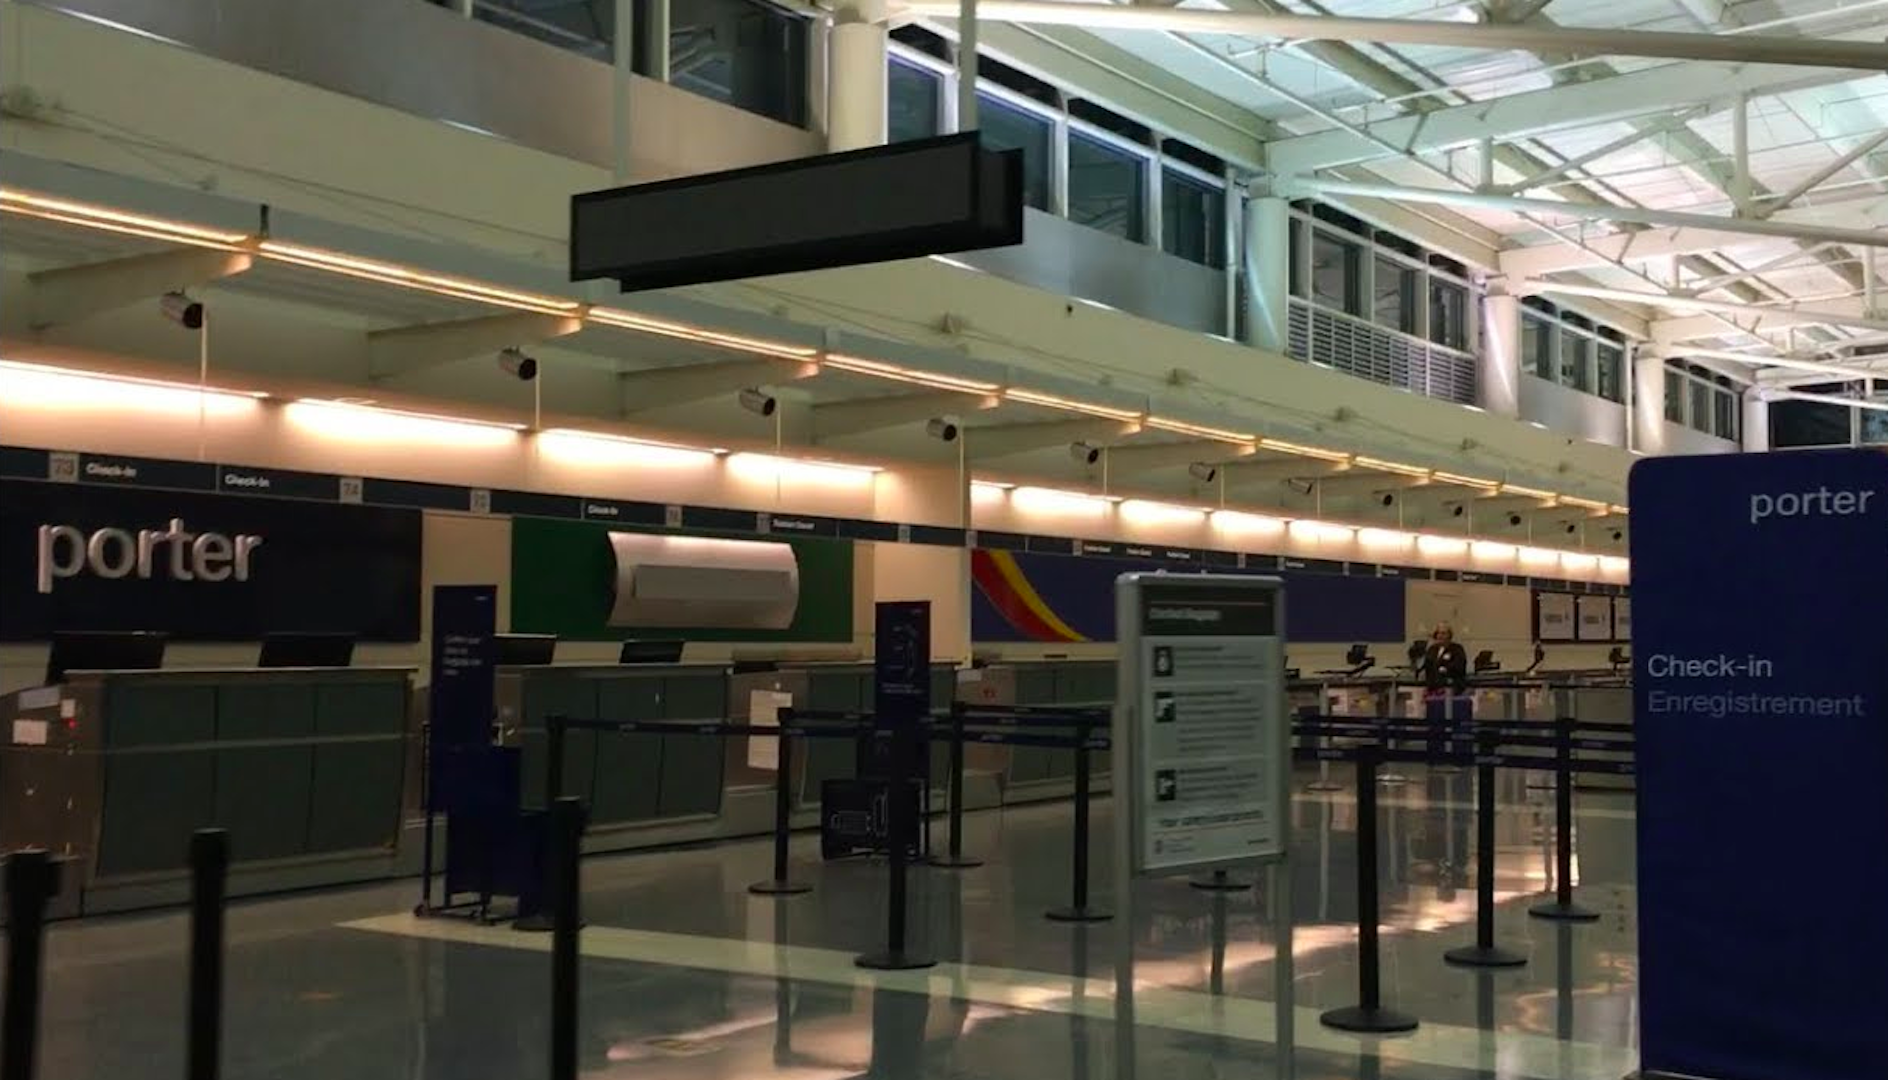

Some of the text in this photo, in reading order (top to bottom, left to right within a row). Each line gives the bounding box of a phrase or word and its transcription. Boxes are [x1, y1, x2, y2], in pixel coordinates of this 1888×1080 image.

[86, 462, 138, 479] Check-in
[224, 473, 270, 489] Check-in
[1750, 485, 1874, 524] porter
[37, 516, 265, 595] porter
[1647, 653, 1773, 678] Check-in
[1647, 689, 1865, 719] Enregistrement
